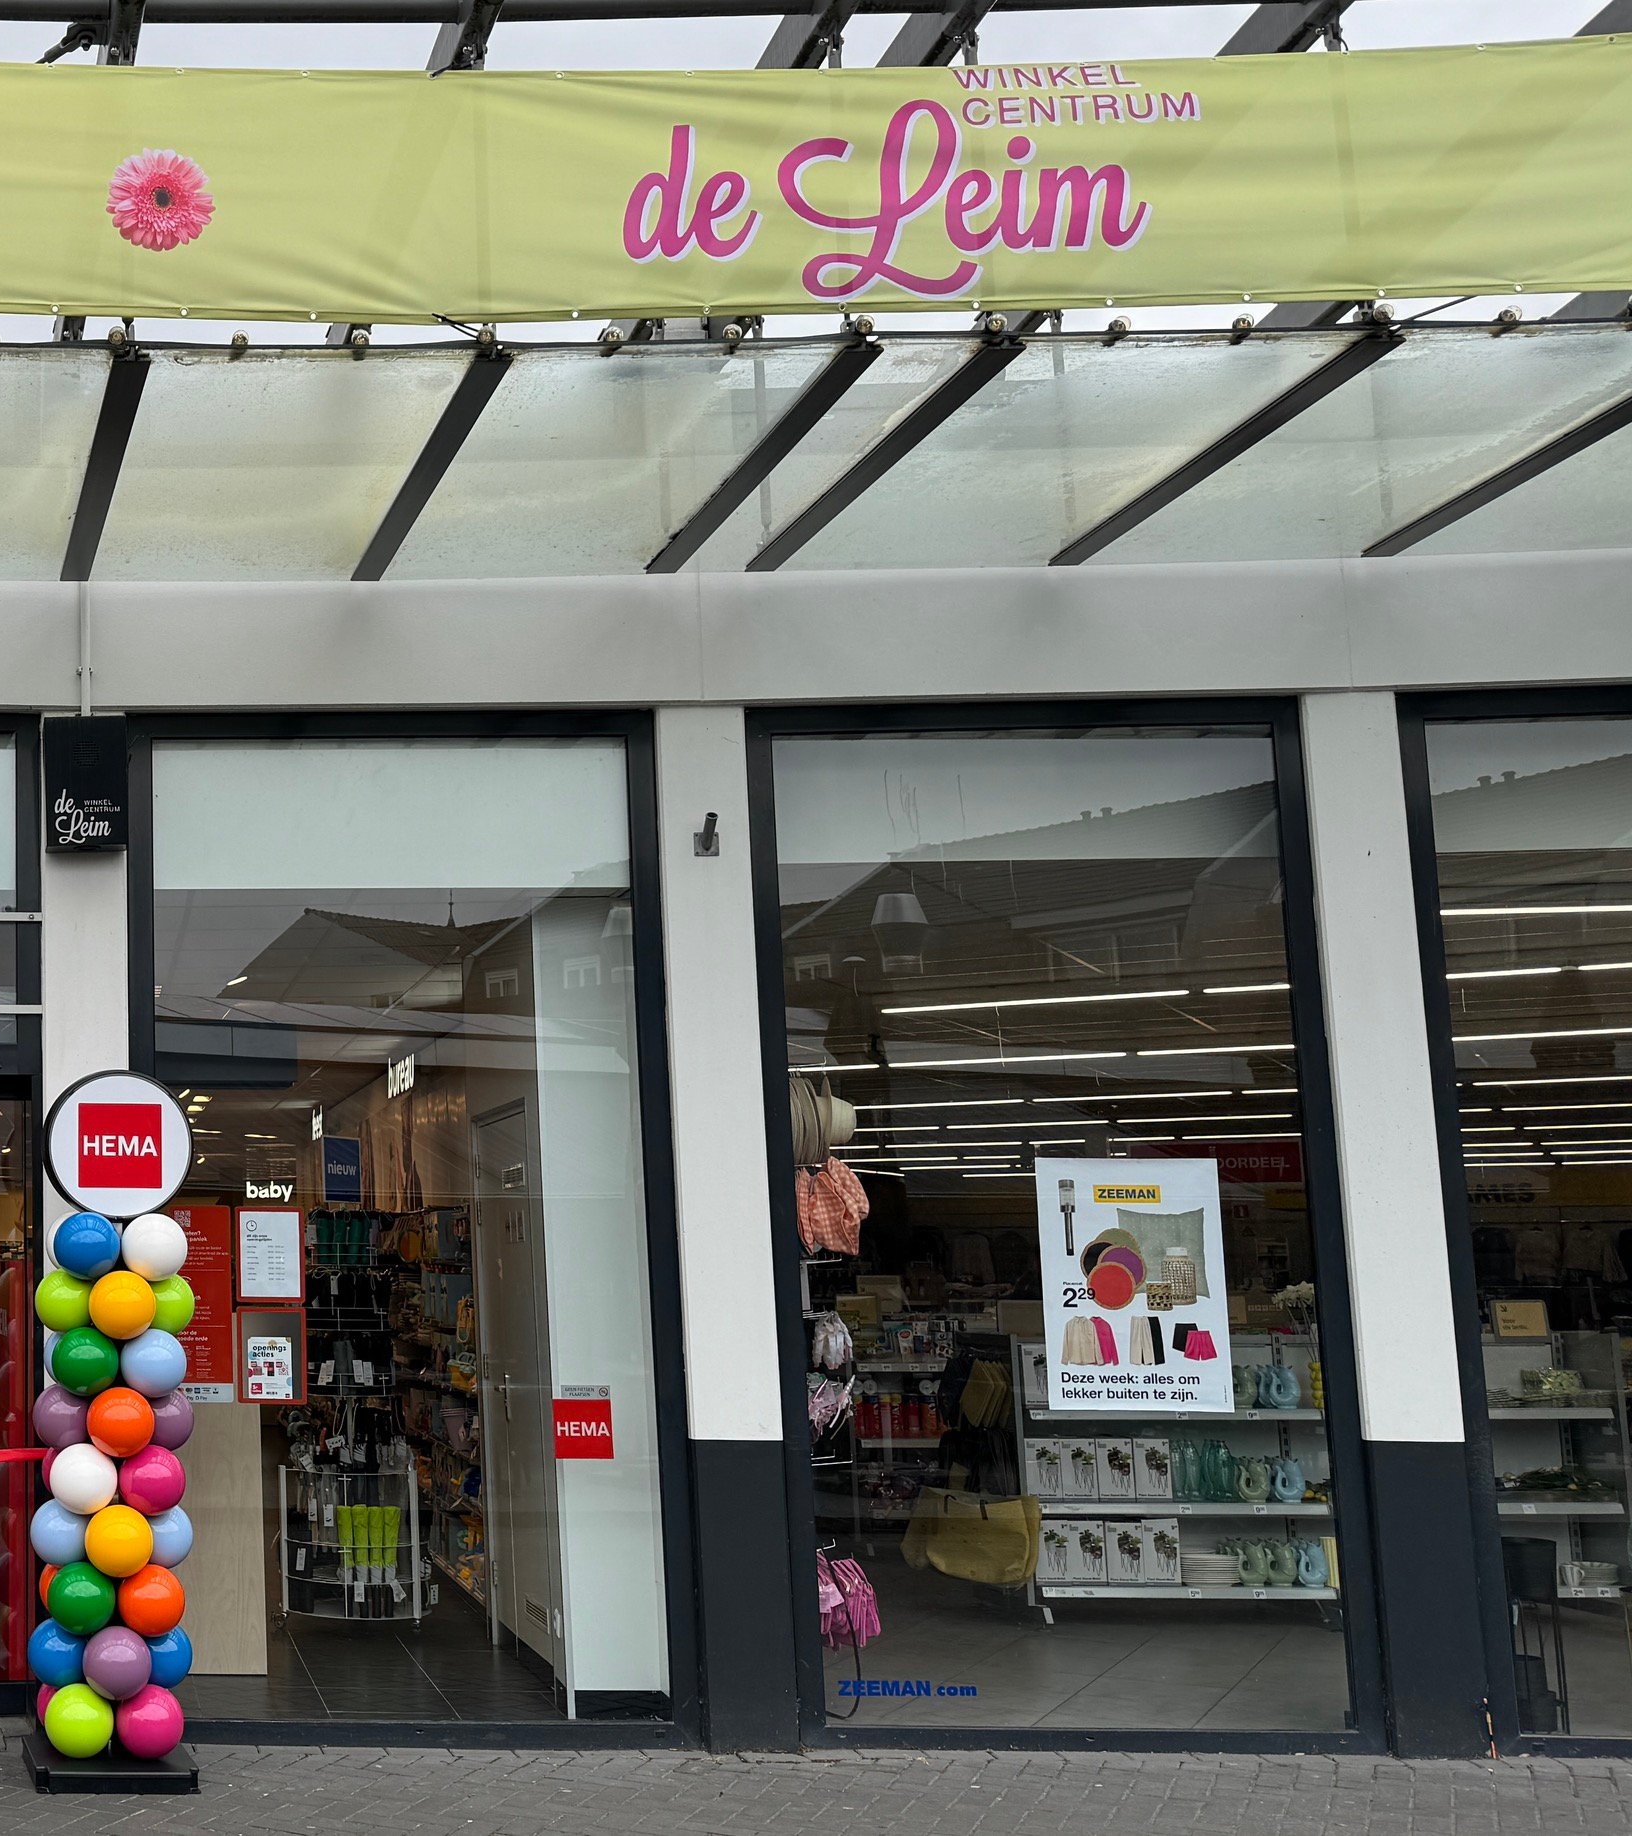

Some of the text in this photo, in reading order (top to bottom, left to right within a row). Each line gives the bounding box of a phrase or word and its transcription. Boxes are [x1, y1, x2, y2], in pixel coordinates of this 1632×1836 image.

[952, 64, 1140, 90] WINKEL
[962, 92, 1200, 128] CENTRUM
[623, 99, 1152, 301] de Leim
[54, 788, 76, 814] de
[55, 808, 112, 844] Leim
[387, 1053, 415, 1099] bureau
[83, 1135, 158, 1157] HEMA
[327, 1160, 357, 1176] nieuw
[245, 1180, 293, 1202] baby
[1097, 1188, 1156, 1200] ZEEMAN
[252, 1344, 287, 1352] openings
[1061, 1372, 1201, 1385] Deze week: alles om
[1061, 1387, 1198, 1403] lekker buiten te zijn.
[556, 1421, 611, 1437] HEMA
